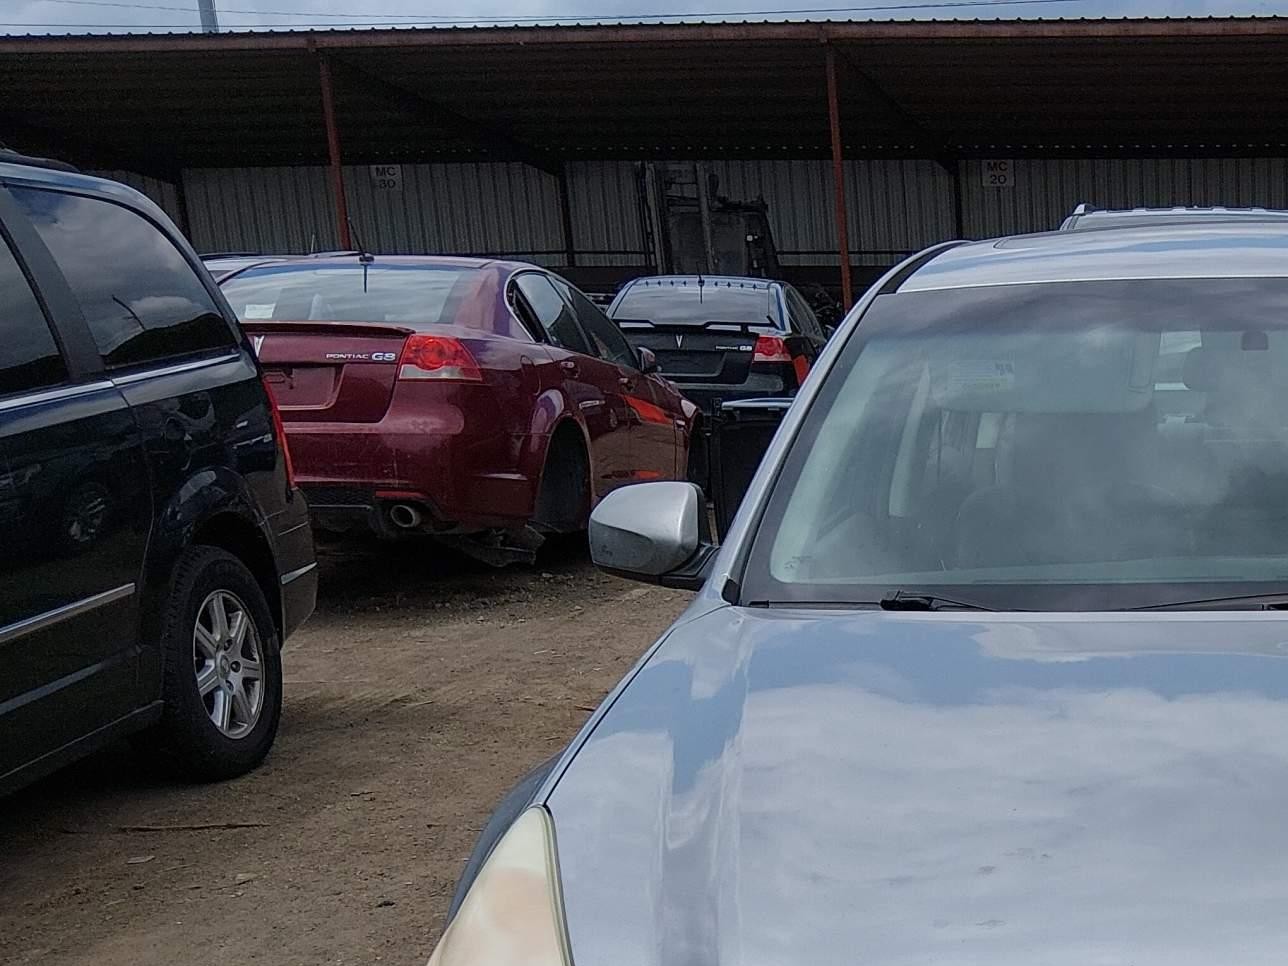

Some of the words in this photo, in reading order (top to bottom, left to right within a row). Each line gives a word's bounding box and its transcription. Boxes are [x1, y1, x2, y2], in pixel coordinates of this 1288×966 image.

[375, 166, 397, 176] MC
[987, 161, 1008, 171] MC
[990, 174, 1007, 184] 20
[371, 352, 396, 361] G8
